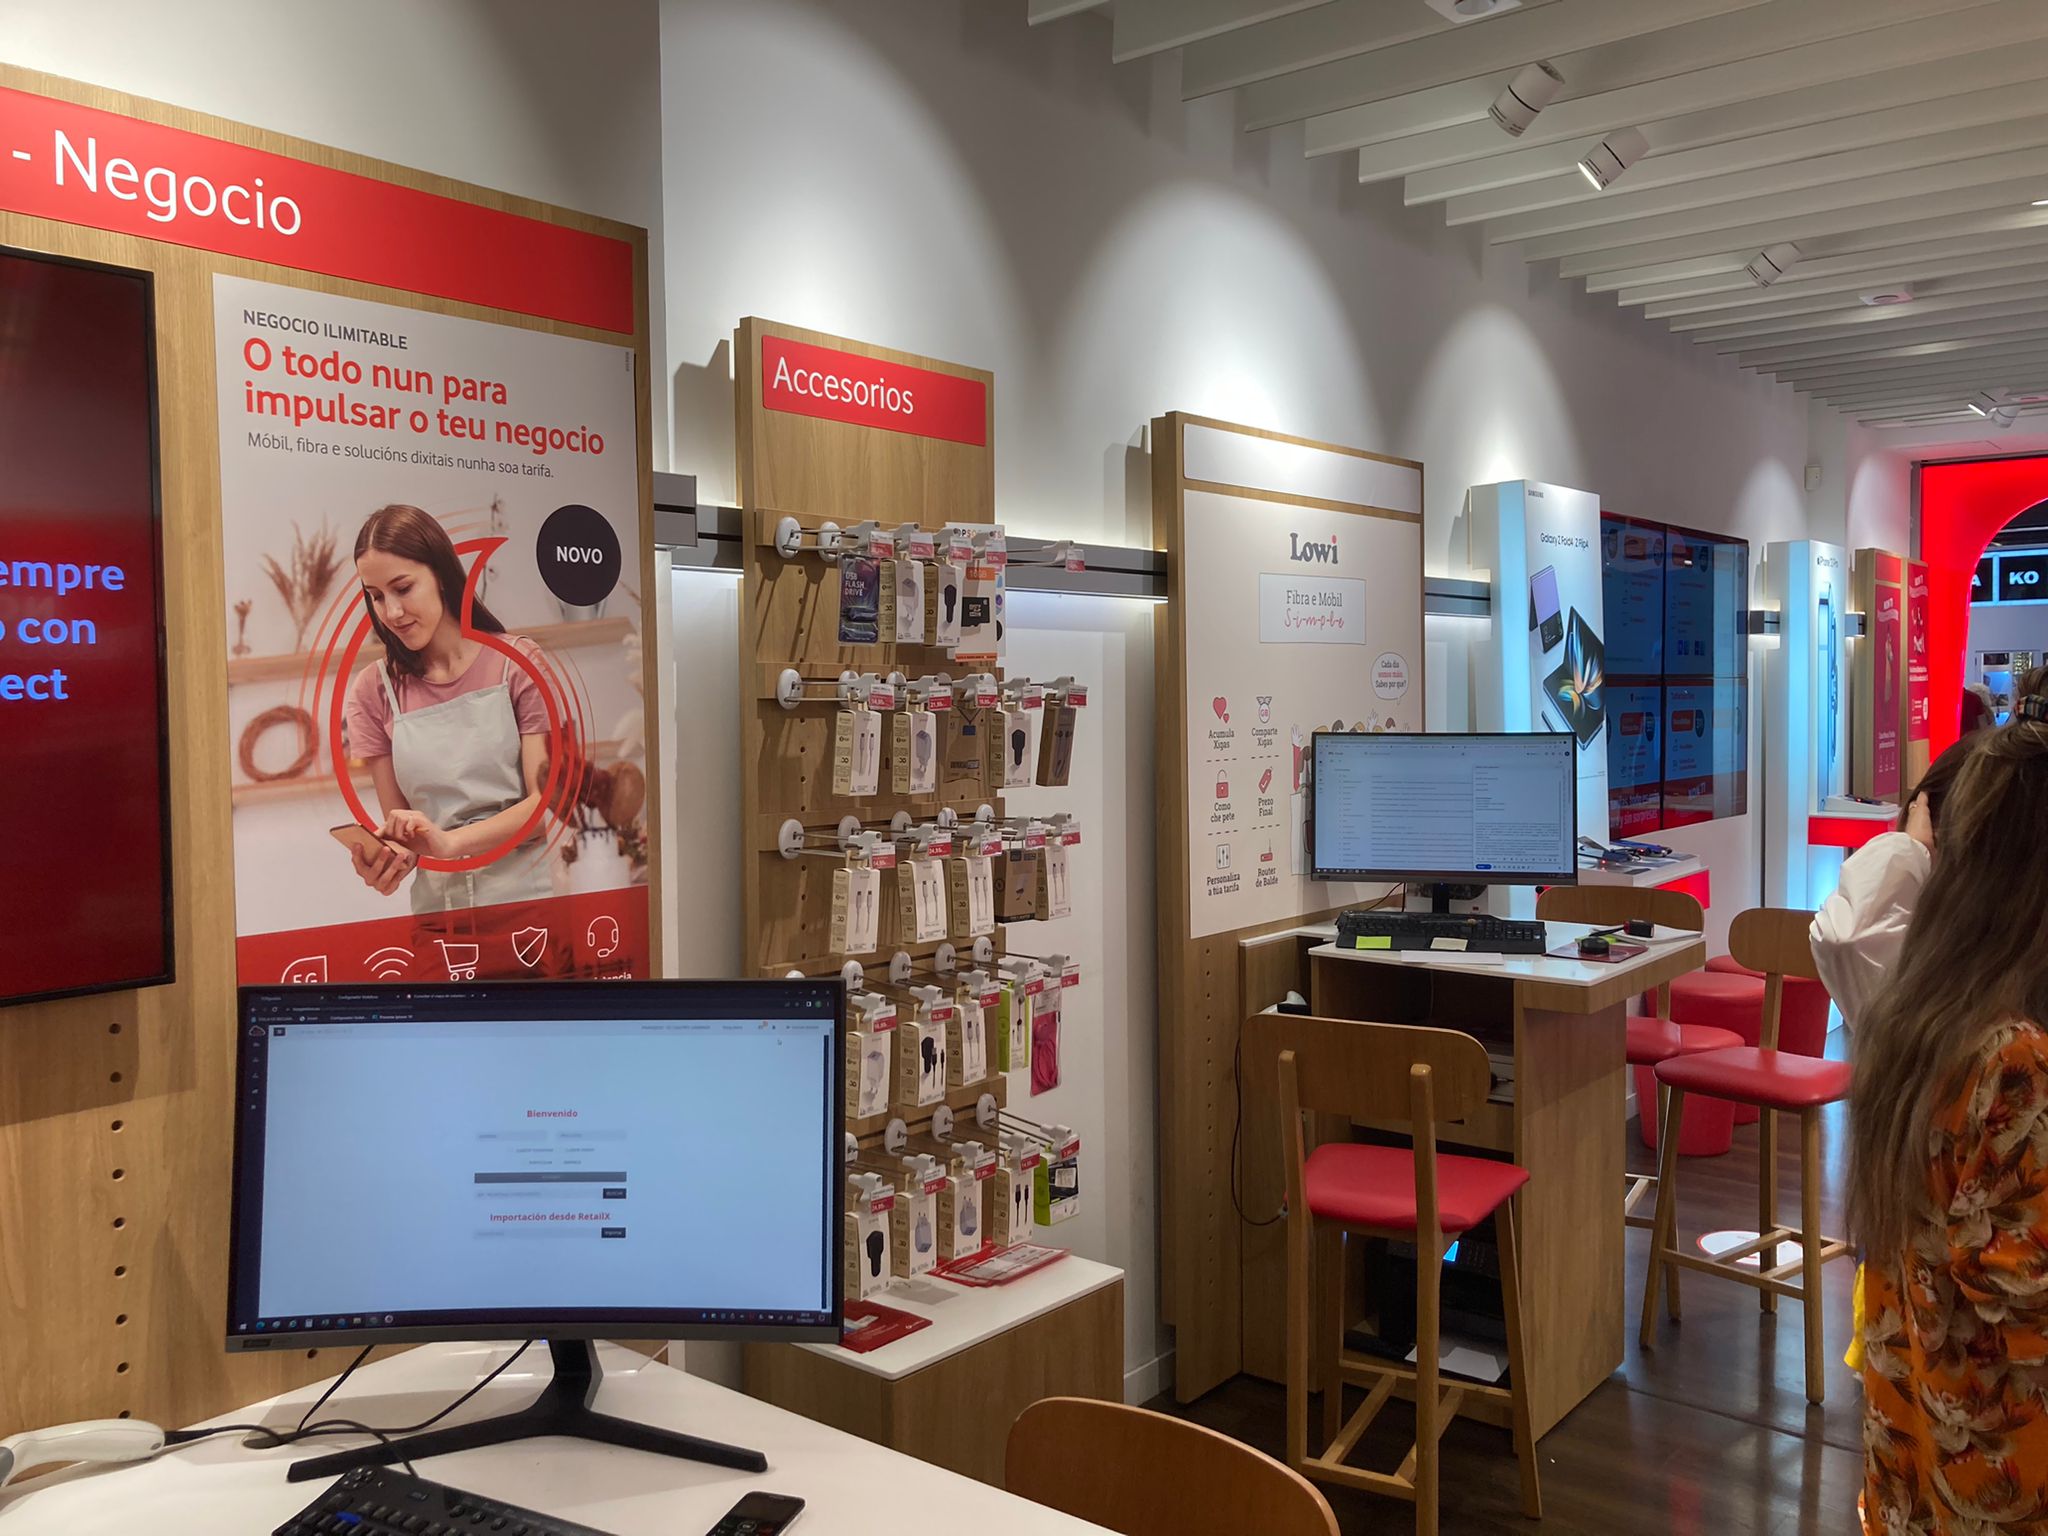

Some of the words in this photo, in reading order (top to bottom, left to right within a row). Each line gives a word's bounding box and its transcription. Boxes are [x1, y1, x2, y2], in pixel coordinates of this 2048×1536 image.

[55, 129, 302, 236] Negocio
[243, 309, 320, 336] NEGOCIO
[323, 322, 408, 350] ILIMITABLE
[243, 337, 272, 372] O
[282, 345, 362, 385] todo
[372, 364, 433, 395] nun
[443, 375, 507, 405] para
[772, 356, 914, 415] Accesorios
[245, 380, 401, 430] impulsar
[409, 410, 429, 434] o
[436, 408, 486, 441] teu
[495, 421, 605, 456] negocio
[247, 431, 293, 453] Móbil,
[296, 437, 328, 455] fibra
[331, 443, 341, 456] e
[344, 444, 408, 464] solucións
[411, 450, 454, 468] dixitais
[456, 456, 496, 473] nunha
[498, 461, 519, 475] soa
[521, 463, 554, 479] tarifa.
[1289, 531, 1339, 565] Lowi
[556, 545, 603, 565] NOVO
[844, 577, 866, 589] FLASH
[2009, 570, 2040, 586] KO
[844, 586, 864, 598] DRIVE
[1286, 590, 1311, 605] Fibra
[1311, 594, 1318, 606] e
[17, 618, 97, 645] con
[1208, 728, 1235, 739] Acumula
[1251, 727, 1278, 738] Comparte
[1213, 739, 1231, 751] Xigas
[1256, 737, 1273, 748] Xigas
[1214, 802, 1232, 812] Como
[1257, 797, 1274, 807] Prezo
[1210, 812, 1221, 823] che
[1258, 806, 1274, 817] Final
[1257, 867, 1277, 877] Router
[1206, 872, 1241, 886] Personaliza
[1255, 878, 1263, 888] de
[1263, 875, 1279, 887] Balde
[1223, 881, 1240, 893] tarifa
[527, 1109, 578, 1118] Bienvenido
[489, 1212, 547, 1223] Importación
[549, 1211, 576, 1221] desde
